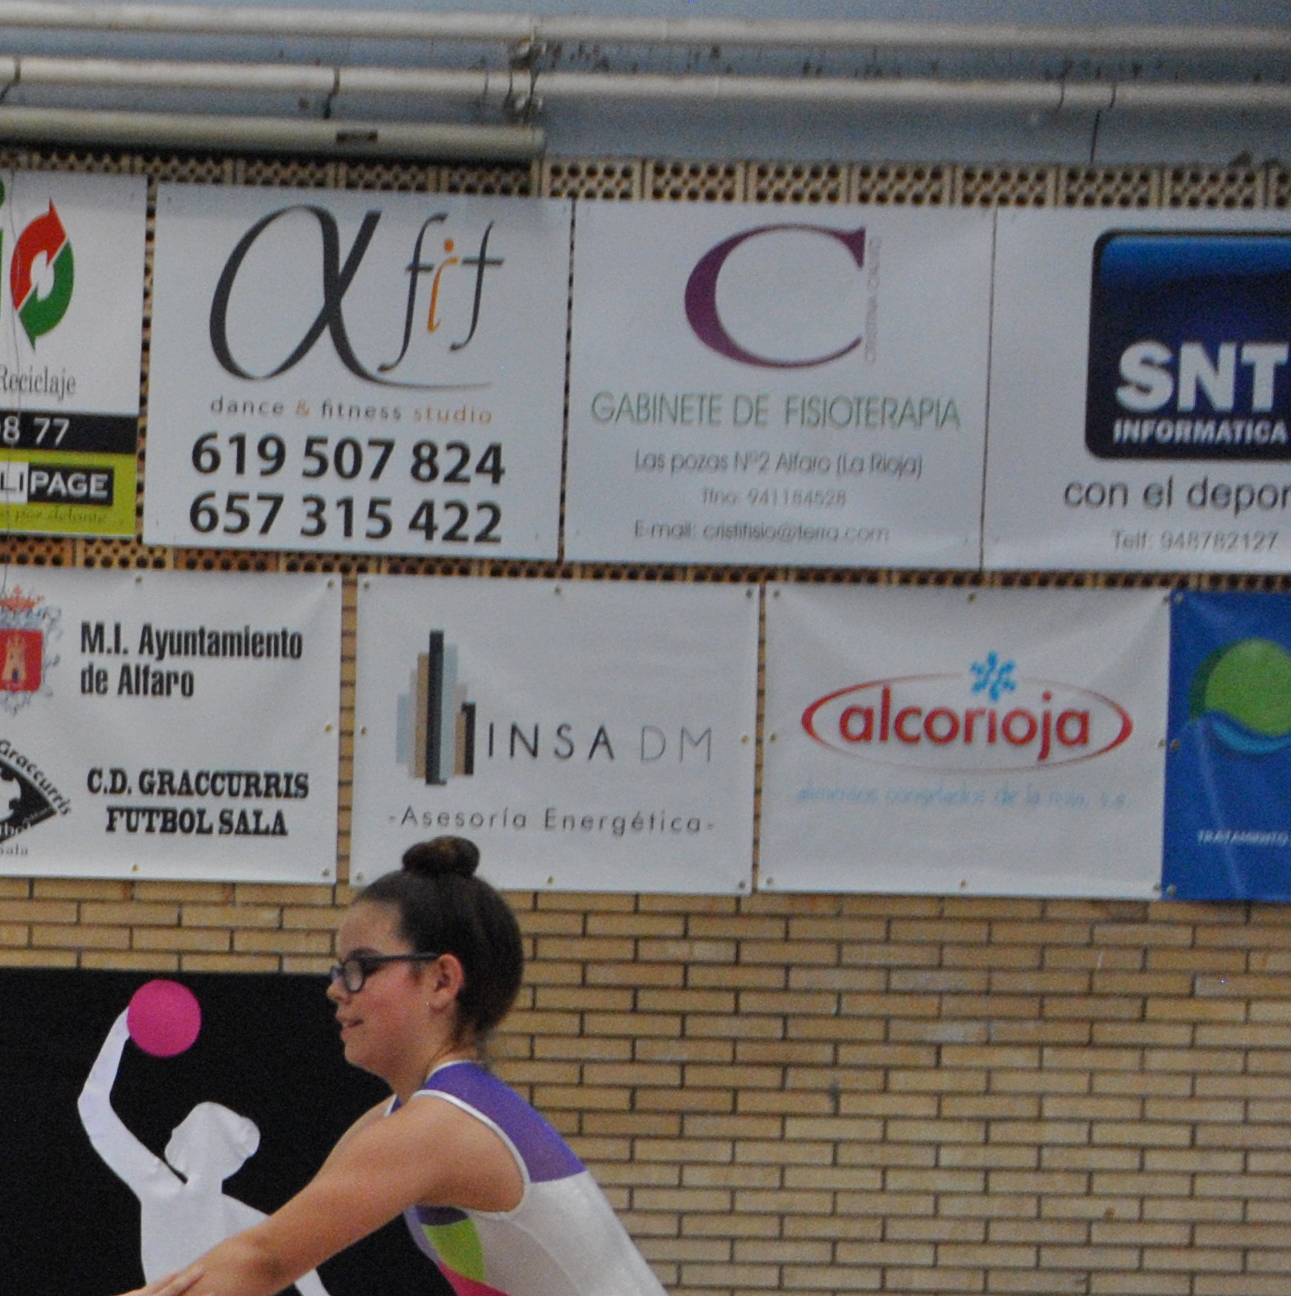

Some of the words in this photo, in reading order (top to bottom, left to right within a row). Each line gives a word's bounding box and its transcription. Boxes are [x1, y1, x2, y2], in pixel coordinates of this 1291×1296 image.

[1116, 338, 1290, 413] SNT
[210, 396, 285, 416] dance
[321, 400, 402, 419] fitness
[413, 404, 493, 424] studio
[590, 391, 723, 425] GABINETE
[733, 395, 769, 426] DE
[785, 395, 962, 431] FISIOTERAPIA
[33, 418, 70, 447] 77
[1113, 418, 1289, 445] INFORMATICA
[191, 431, 287, 477] 619
[301, 435, 396, 481] 507
[409, 438, 506, 485] 824
[1064, 481, 1129, 509] con
[1142, 474, 1174, 509] el
[189, 490, 285, 535] 657
[300, 493, 393, 540] 315
[408, 498, 503, 544] 422
[80, 620, 129, 655] M.I.
[138, 622, 304, 662] Ayuntamiento
[80, 662, 109, 696] de
[117, 662, 195, 698] Alfaro
[839, 684, 1091, 762] alcorioja
[488, 721, 616, 762] INSA
[639, 724, 713, 764] DM
[87, 766, 132, 796] C.D.
[138, 768, 310, 799] GRACCURRIS
[106, 805, 214, 836] FUTBOL
[218, 807, 289, 837] SALA
